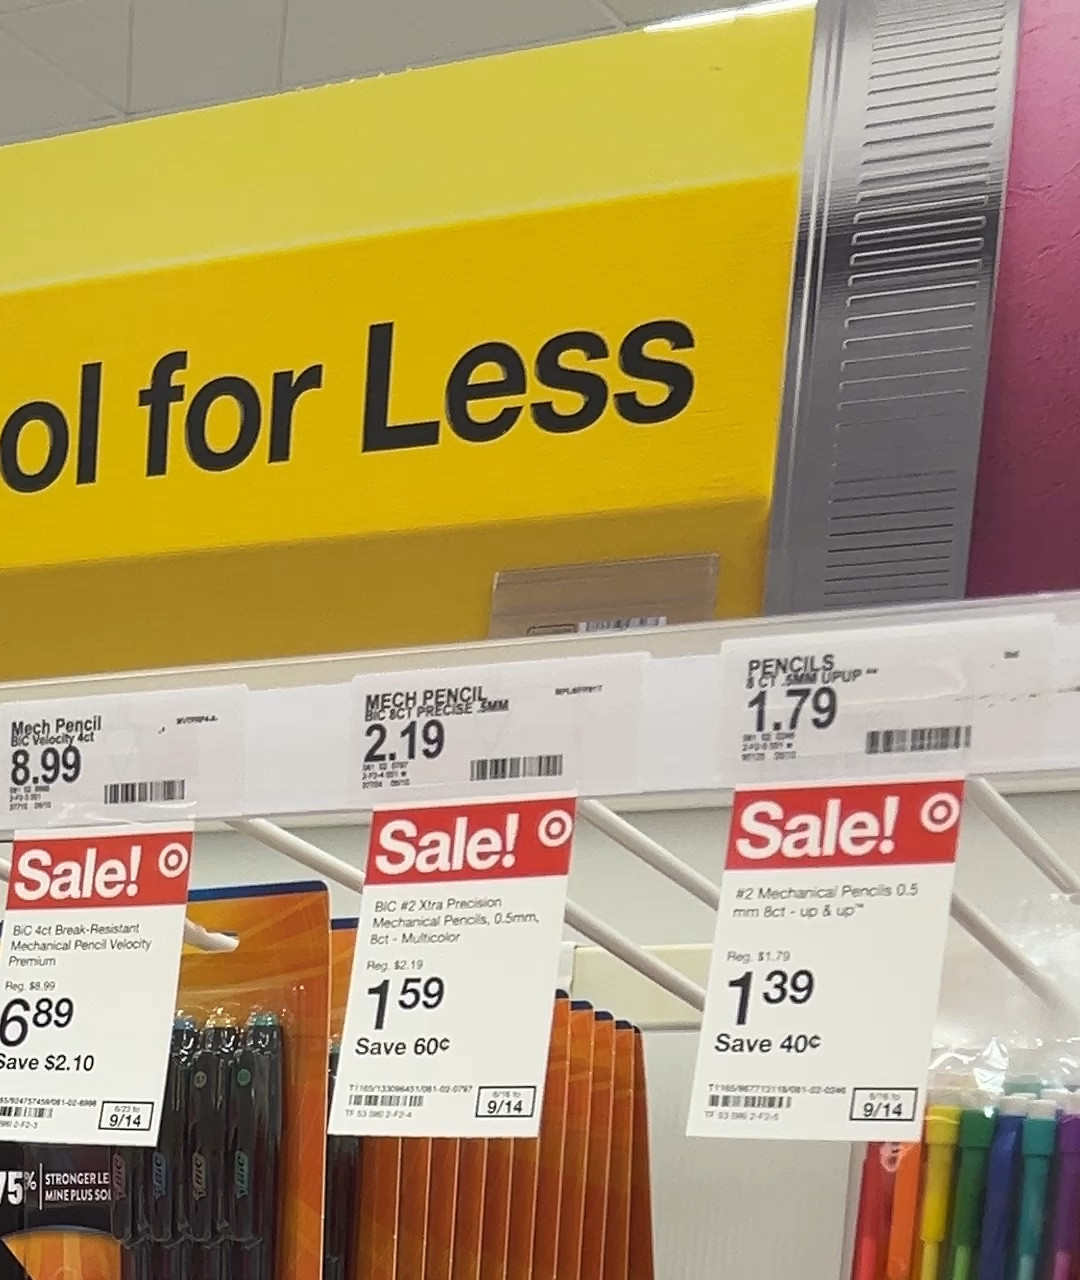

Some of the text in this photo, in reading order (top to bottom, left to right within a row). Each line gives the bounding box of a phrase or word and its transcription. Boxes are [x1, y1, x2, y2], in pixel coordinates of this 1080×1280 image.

[137, 351, 322, 477] for
[360, 318, 696, 453] Less
[749, 654, 834, 676] PENCILS
[365, 686, 488, 710] MECH PENCIL
[417, 703, 473, 718] PRECISE
[748, 686, 837, 732] 1.79
[11, 715, 101, 737] Mech Pencil
[364, 719, 445, 763] 2.19
[11, 746, 81, 785] 8.99
[736, 796, 900, 860] Sale!
[375, 813, 519, 875] Sale!
[14, 845, 142, 900] Sale!
[757, 884, 891, 899] Mechanical Pencils
[419, 897, 501, 911] Xtra Precision
[55, 923, 140, 936] Break-Resistant
[373, 916, 440, 928] Mechanical
[10, 939, 152, 952] Mechanical Pencil Velocity
[401, 931, 460, 944] Multicolor
[8, 955, 56, 967] Premium
[355, 1037, 406, 1055] Save
[715, 1033, 771, 1053] Save
[44, 1054, 94, 1072] $2.10
[487, 1100, 522, 1114] 9/14
[863, 1103, 903, 1117] 9/14
[109, 1113, 141, 1128] 9/14
[45, 1173, 97, 1185] STRONGER
[45, 1189, 92, 1201] MINE PLUS
